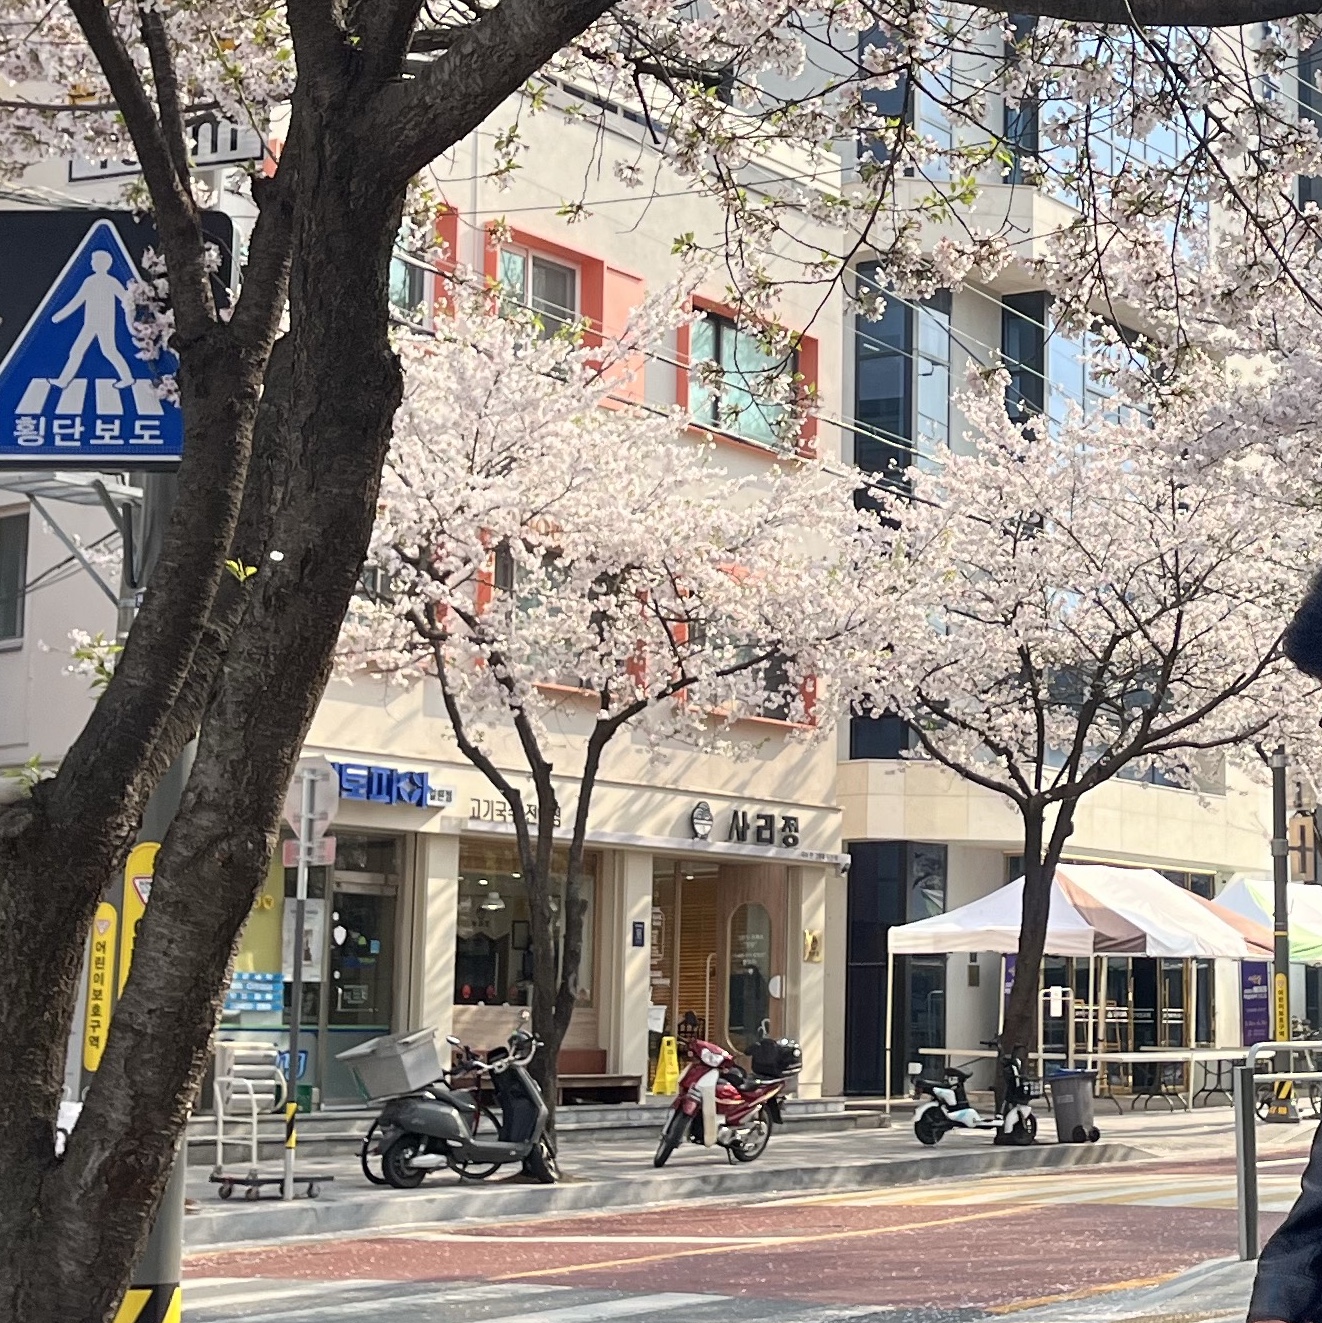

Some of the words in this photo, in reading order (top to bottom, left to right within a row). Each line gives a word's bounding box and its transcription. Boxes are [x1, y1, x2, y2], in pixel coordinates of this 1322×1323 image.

[13, 416, 164, 446] 횡단보도
[330, 762, 429, 809] 토피아
[728, 809, 800, 848] 사리정
[88, 940, 107, 1049] 어린이보호구역
